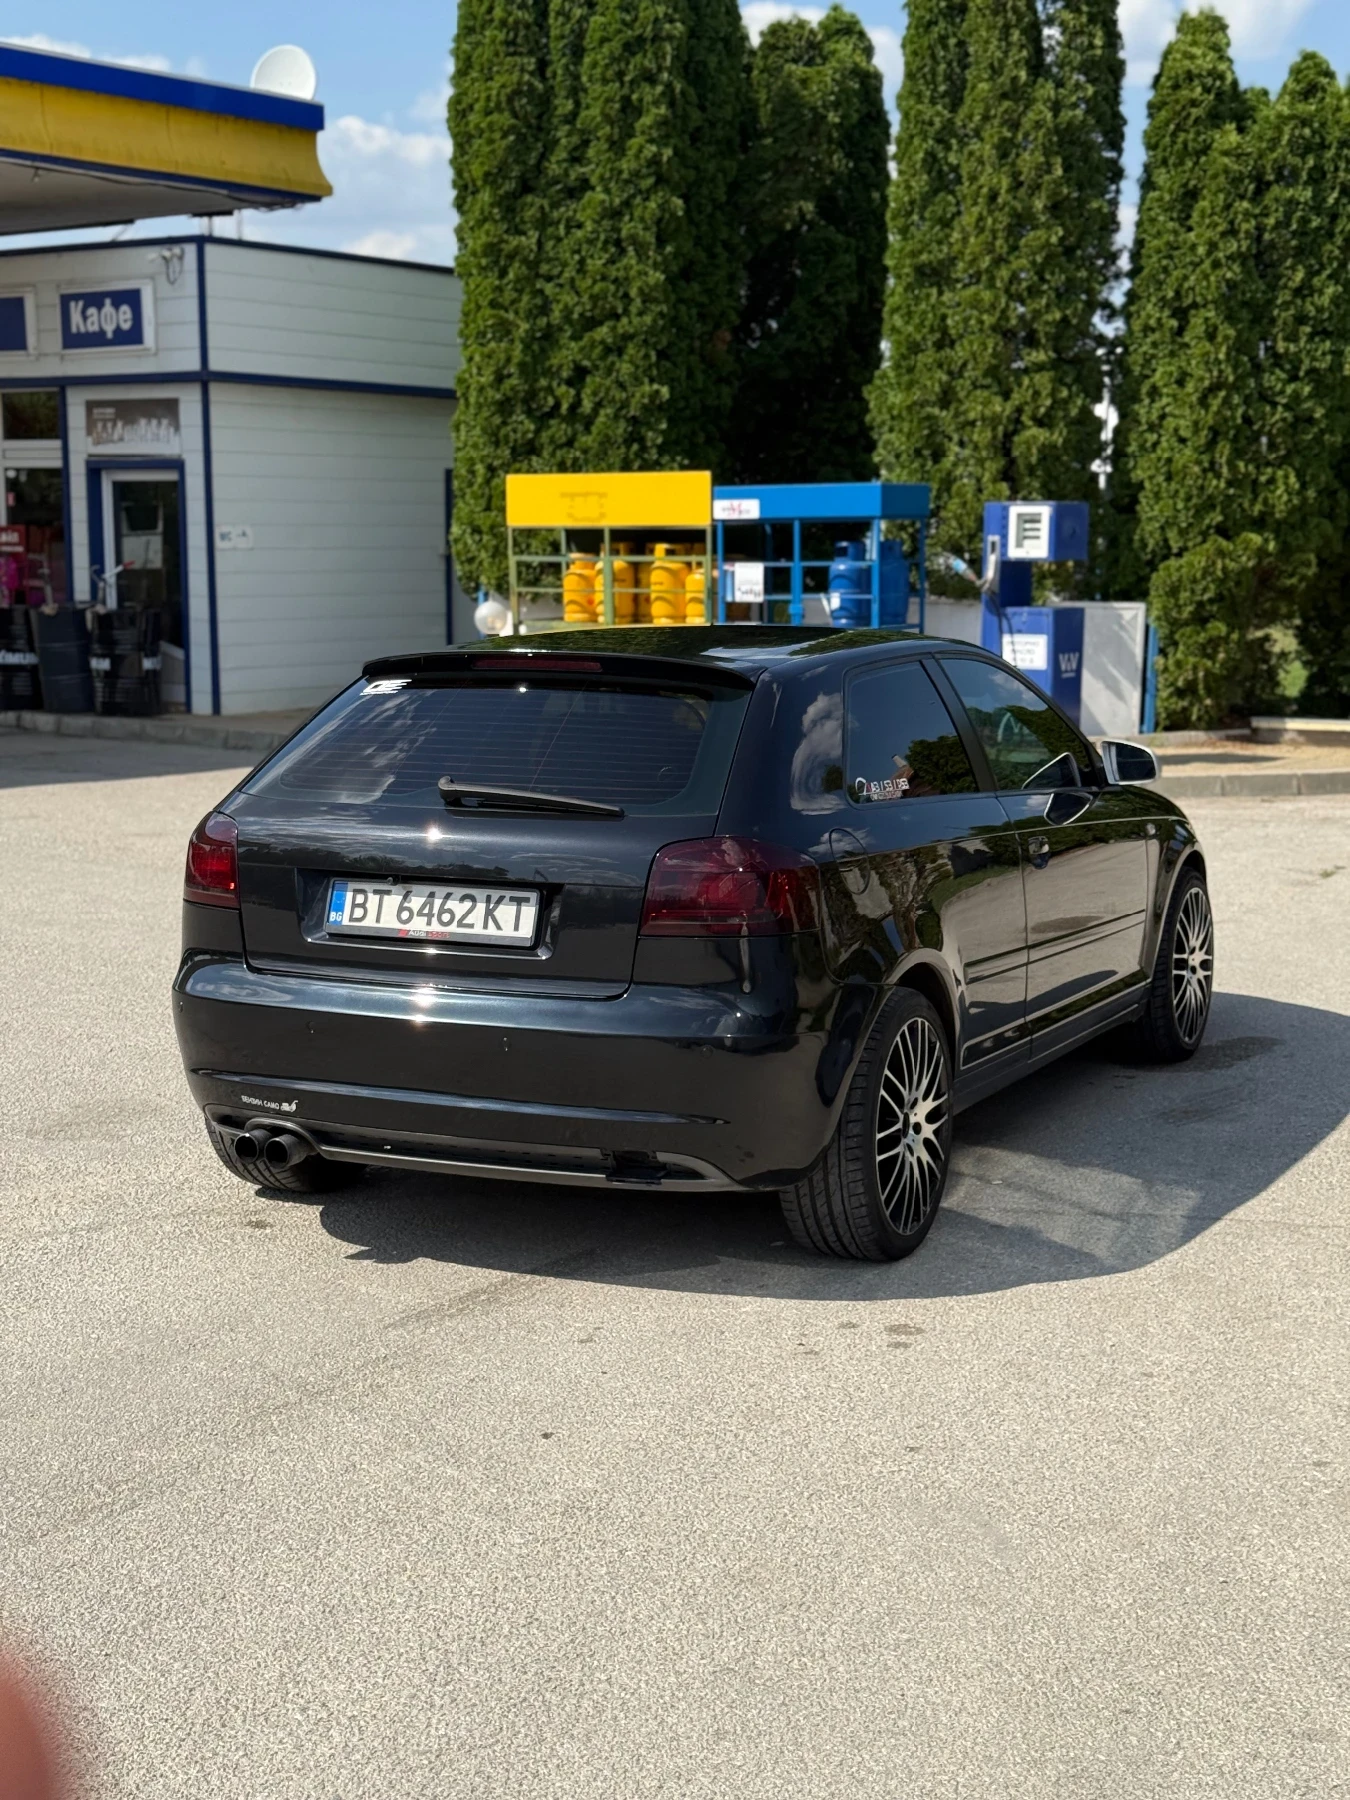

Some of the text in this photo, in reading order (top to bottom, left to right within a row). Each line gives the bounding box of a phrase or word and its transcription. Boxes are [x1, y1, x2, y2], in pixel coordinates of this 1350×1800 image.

[69, 298, 133, 339] Кафе
[329, 911, 343, 922] BG
[348, 889, 531, 932] BT 6462 KT
